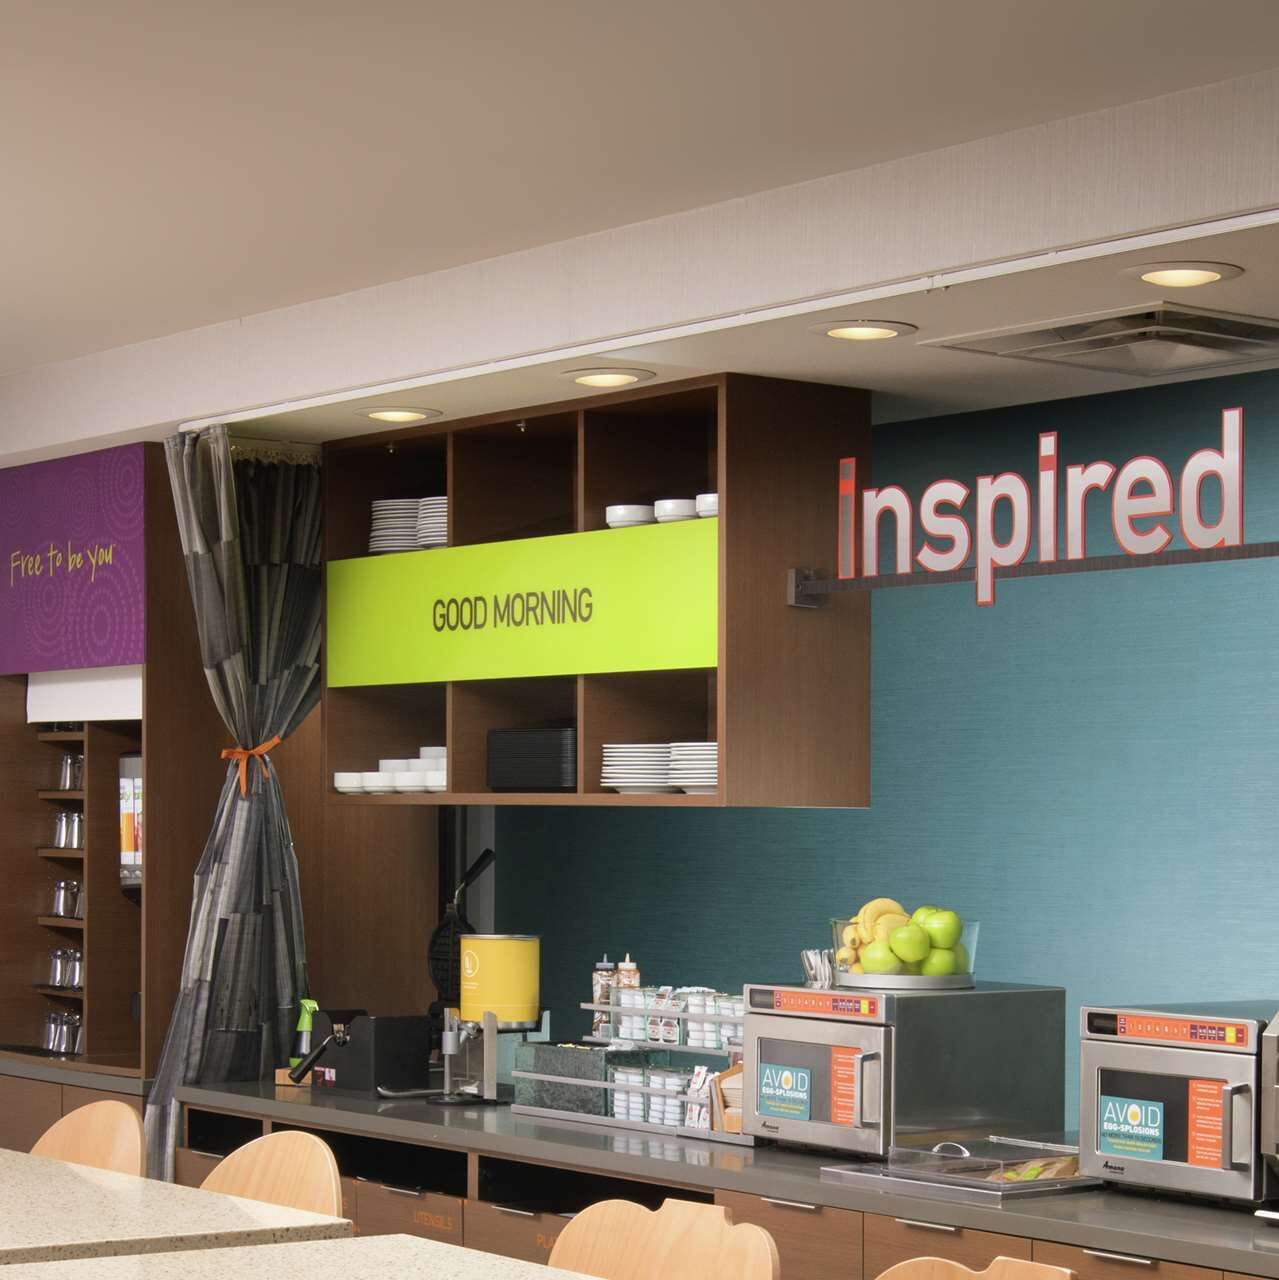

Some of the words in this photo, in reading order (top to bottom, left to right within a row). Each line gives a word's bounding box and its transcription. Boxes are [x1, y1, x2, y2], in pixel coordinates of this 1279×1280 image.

[837, 405, 1244, 607] inspired
[10, 550, 43, 587] Free
[47, 543, 62, 577] to
[67, 540, 84, 573] be
[86, 544, 113, 583] you
[433, 596, 487, 632] GOOD
[493, 587, 593, 628] MORNING
[762, 1067, 808, 1091] AVOID
[1104, 1101, 1160, 1127] AVOID
